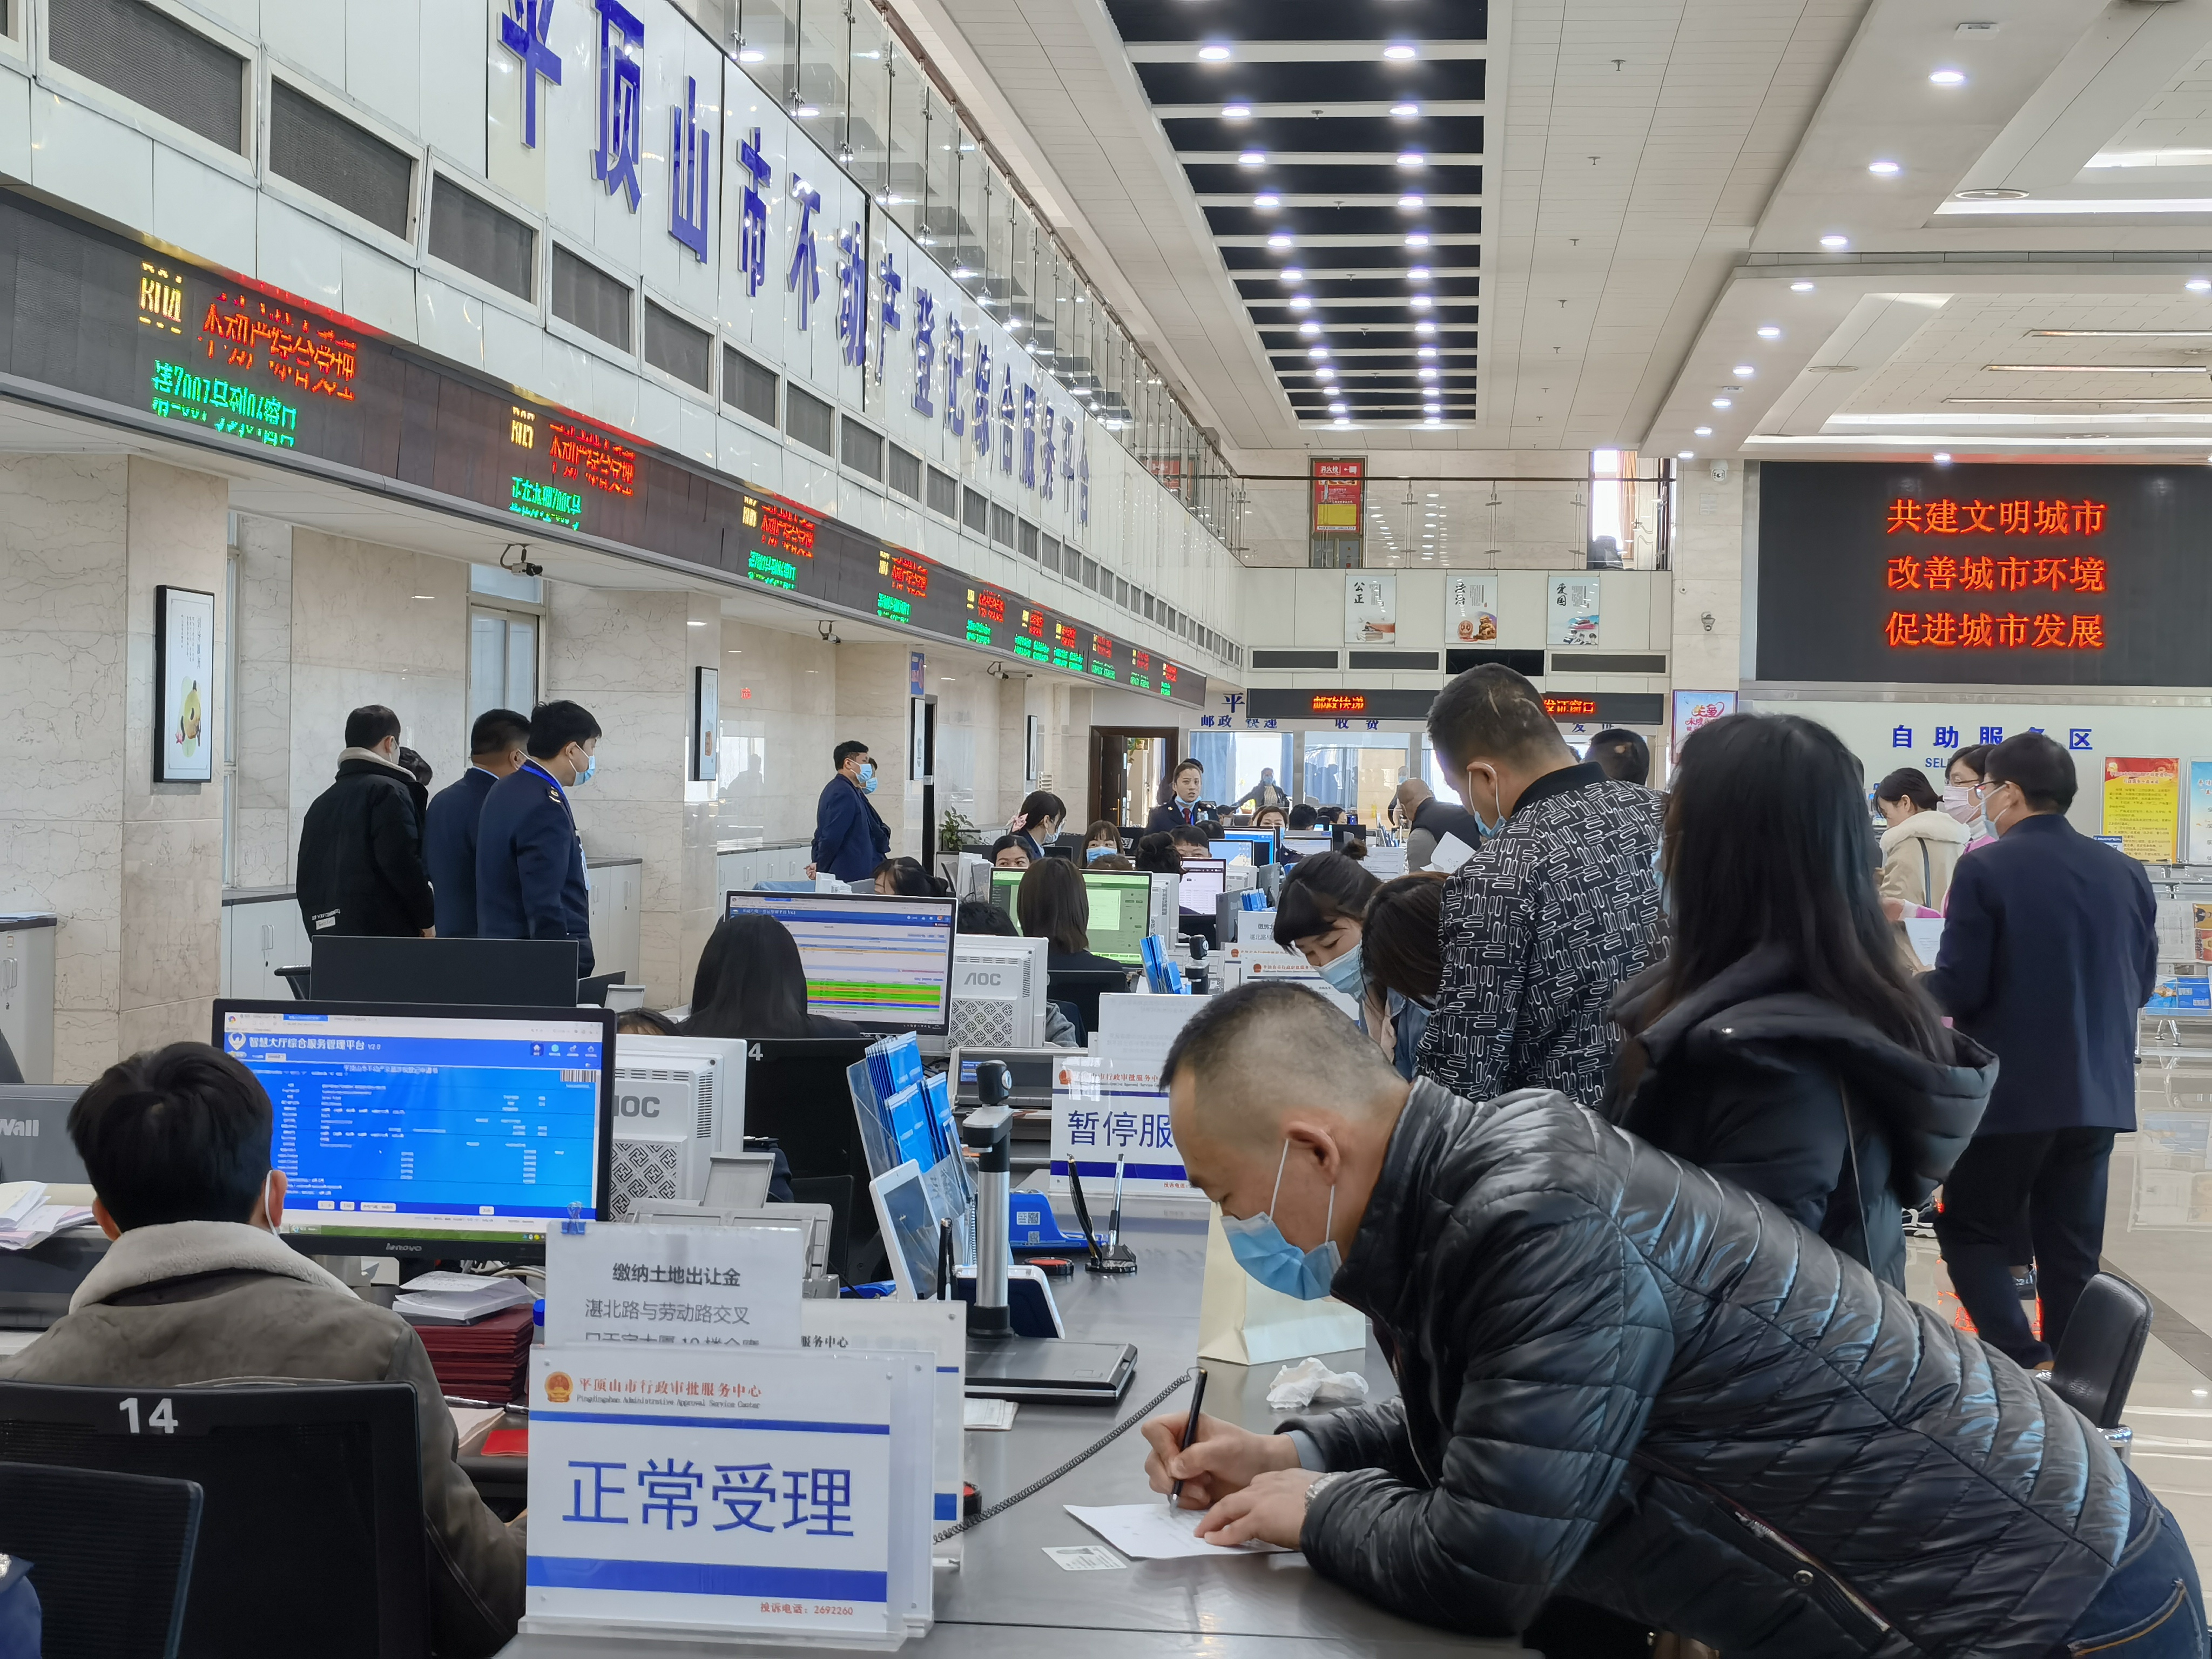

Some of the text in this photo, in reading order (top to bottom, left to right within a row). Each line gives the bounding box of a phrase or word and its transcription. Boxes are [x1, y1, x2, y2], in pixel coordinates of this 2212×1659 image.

[1887, 498, 2108, 536] 共建文明城市
[1886, 555, 2107, 592] 改善城市环境
[1354, 582, 1365, 604] 公正
[1557, 583, 1568, 606] 爱国
[1885, 611, 2105, 649] 促进城市发展
[1893, 724, 2093, 750] 自助服区
[1925, 757, 1947, 768] SEL
[964, 973, 1001, 986] AOC
[1068, 1110, 1174, 1148] 暂停服
[612, 1263, 741, 1287] 缴纳土地出让金
[585, 1299, 750, 1325] 湛北路与劳动路交叉
[579, 1377, 762, 1398] 平顶山市行政审批服务中心
[119, 1398, 178, 1434] 14
[562, 1458, 854, 1537] 正常受理
[814, 1605, 853, 1615] 2692260
